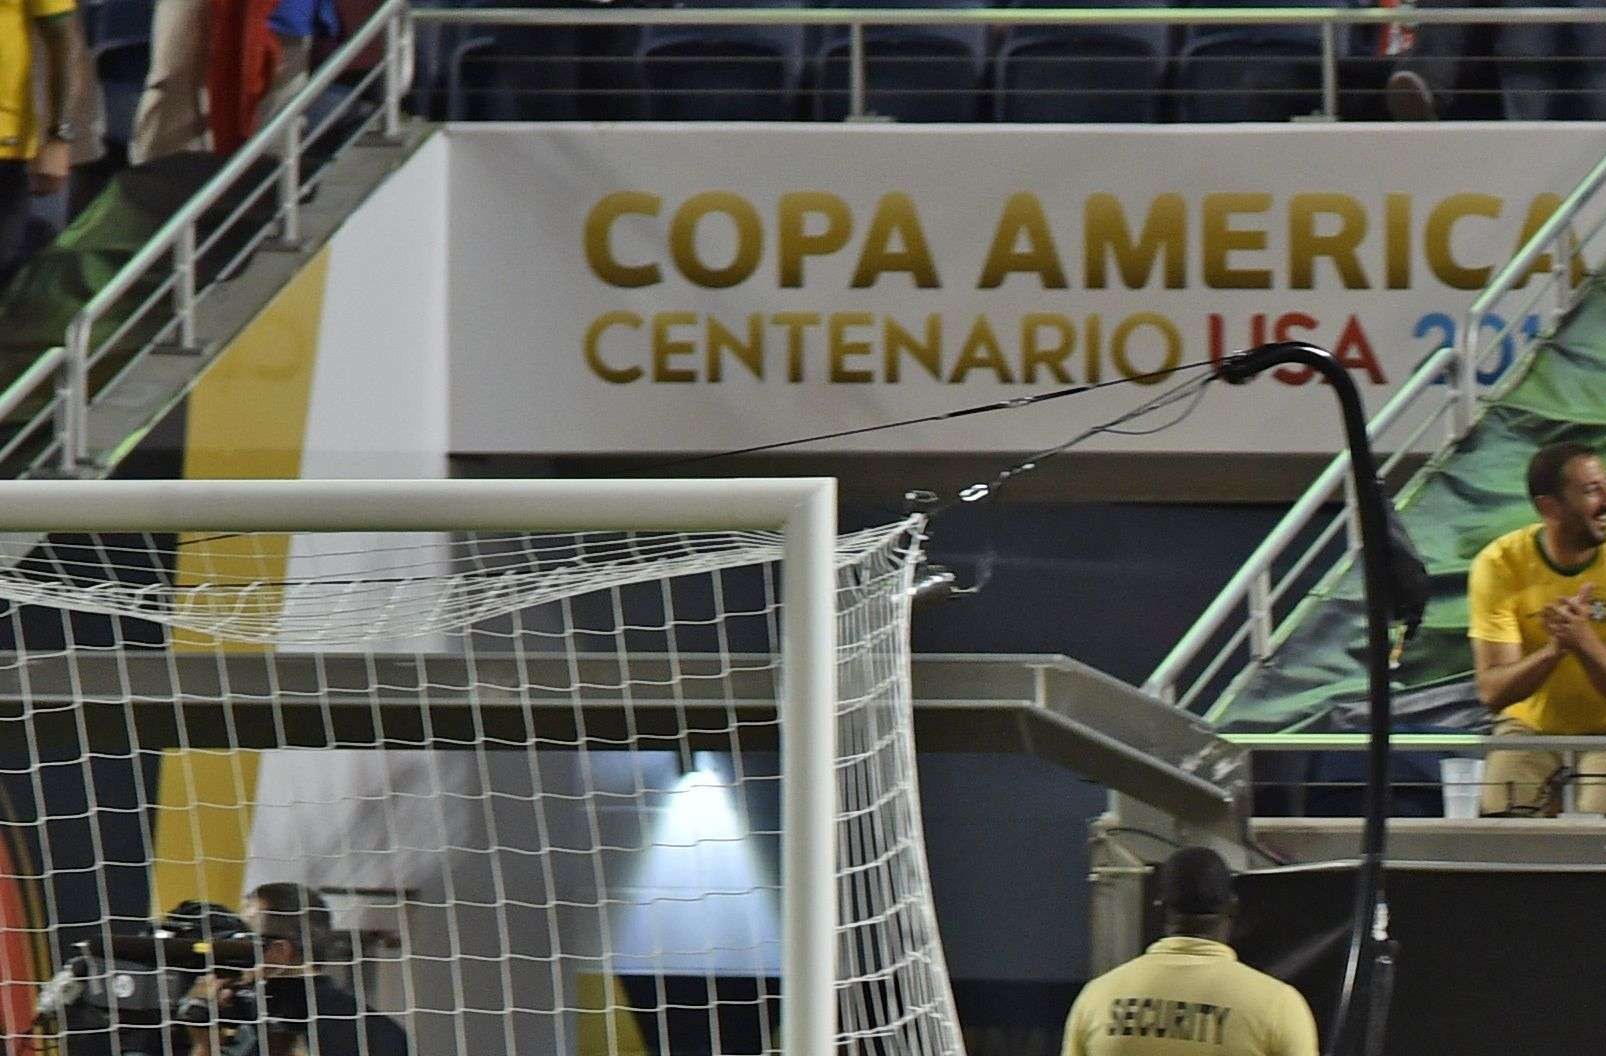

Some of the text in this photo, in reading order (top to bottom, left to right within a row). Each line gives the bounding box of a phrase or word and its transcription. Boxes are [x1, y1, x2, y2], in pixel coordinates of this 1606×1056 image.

[583, 190, 1587, 291] COPA AMERICA
[583, 311, 1184, 386] CENTENARIO
[1208, 311, 1389, 386] USA
[1107, 998, 1232, 1046] SECURITY
